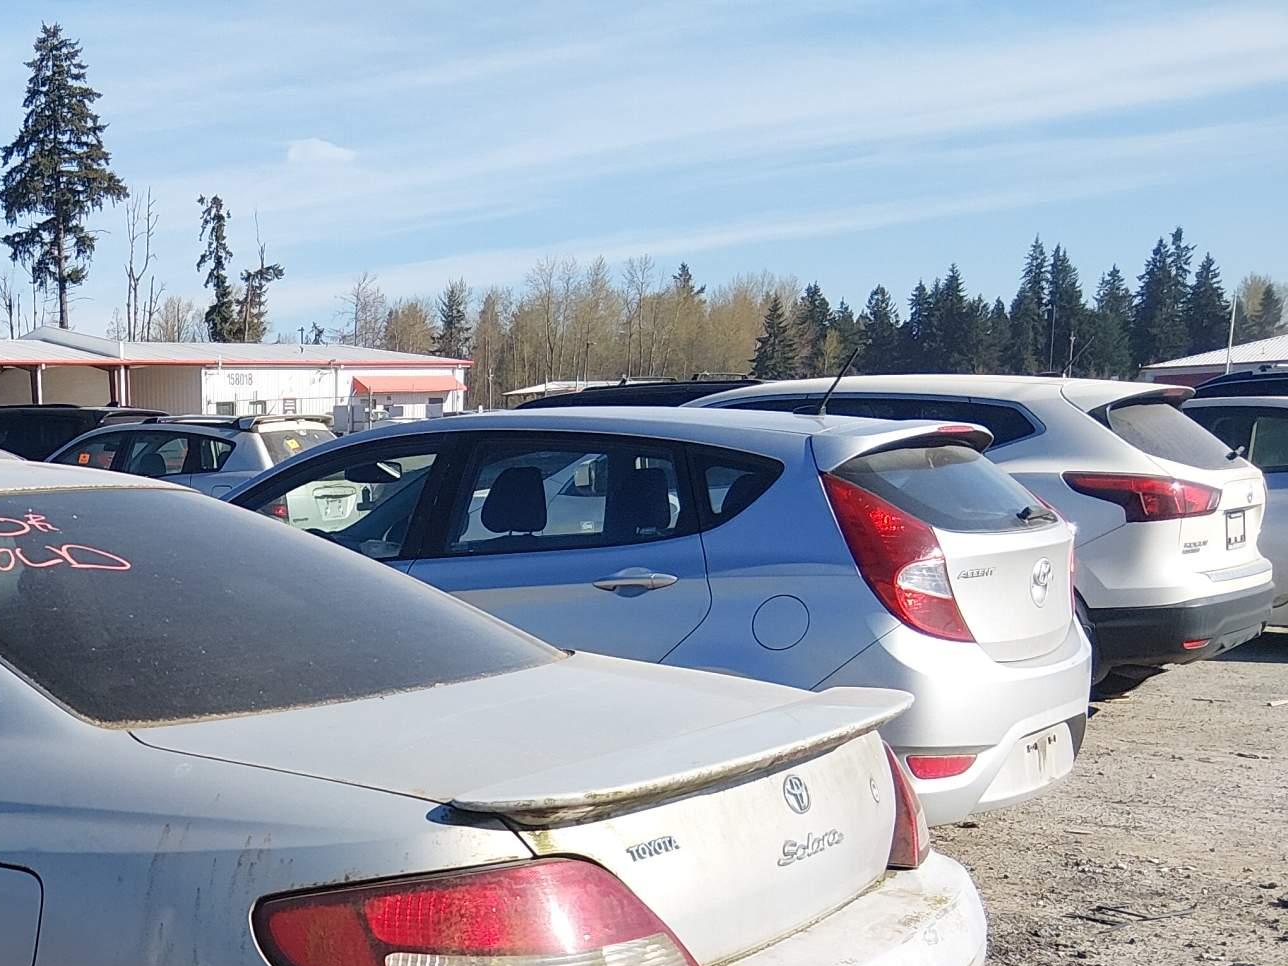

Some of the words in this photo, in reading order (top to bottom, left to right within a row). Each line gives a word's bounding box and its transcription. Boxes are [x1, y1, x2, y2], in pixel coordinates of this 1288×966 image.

[226, 372, 253, 386] 158018
[626, 836, 680, 862] TOYOTA
[777, 829, 845, 867] Solara
